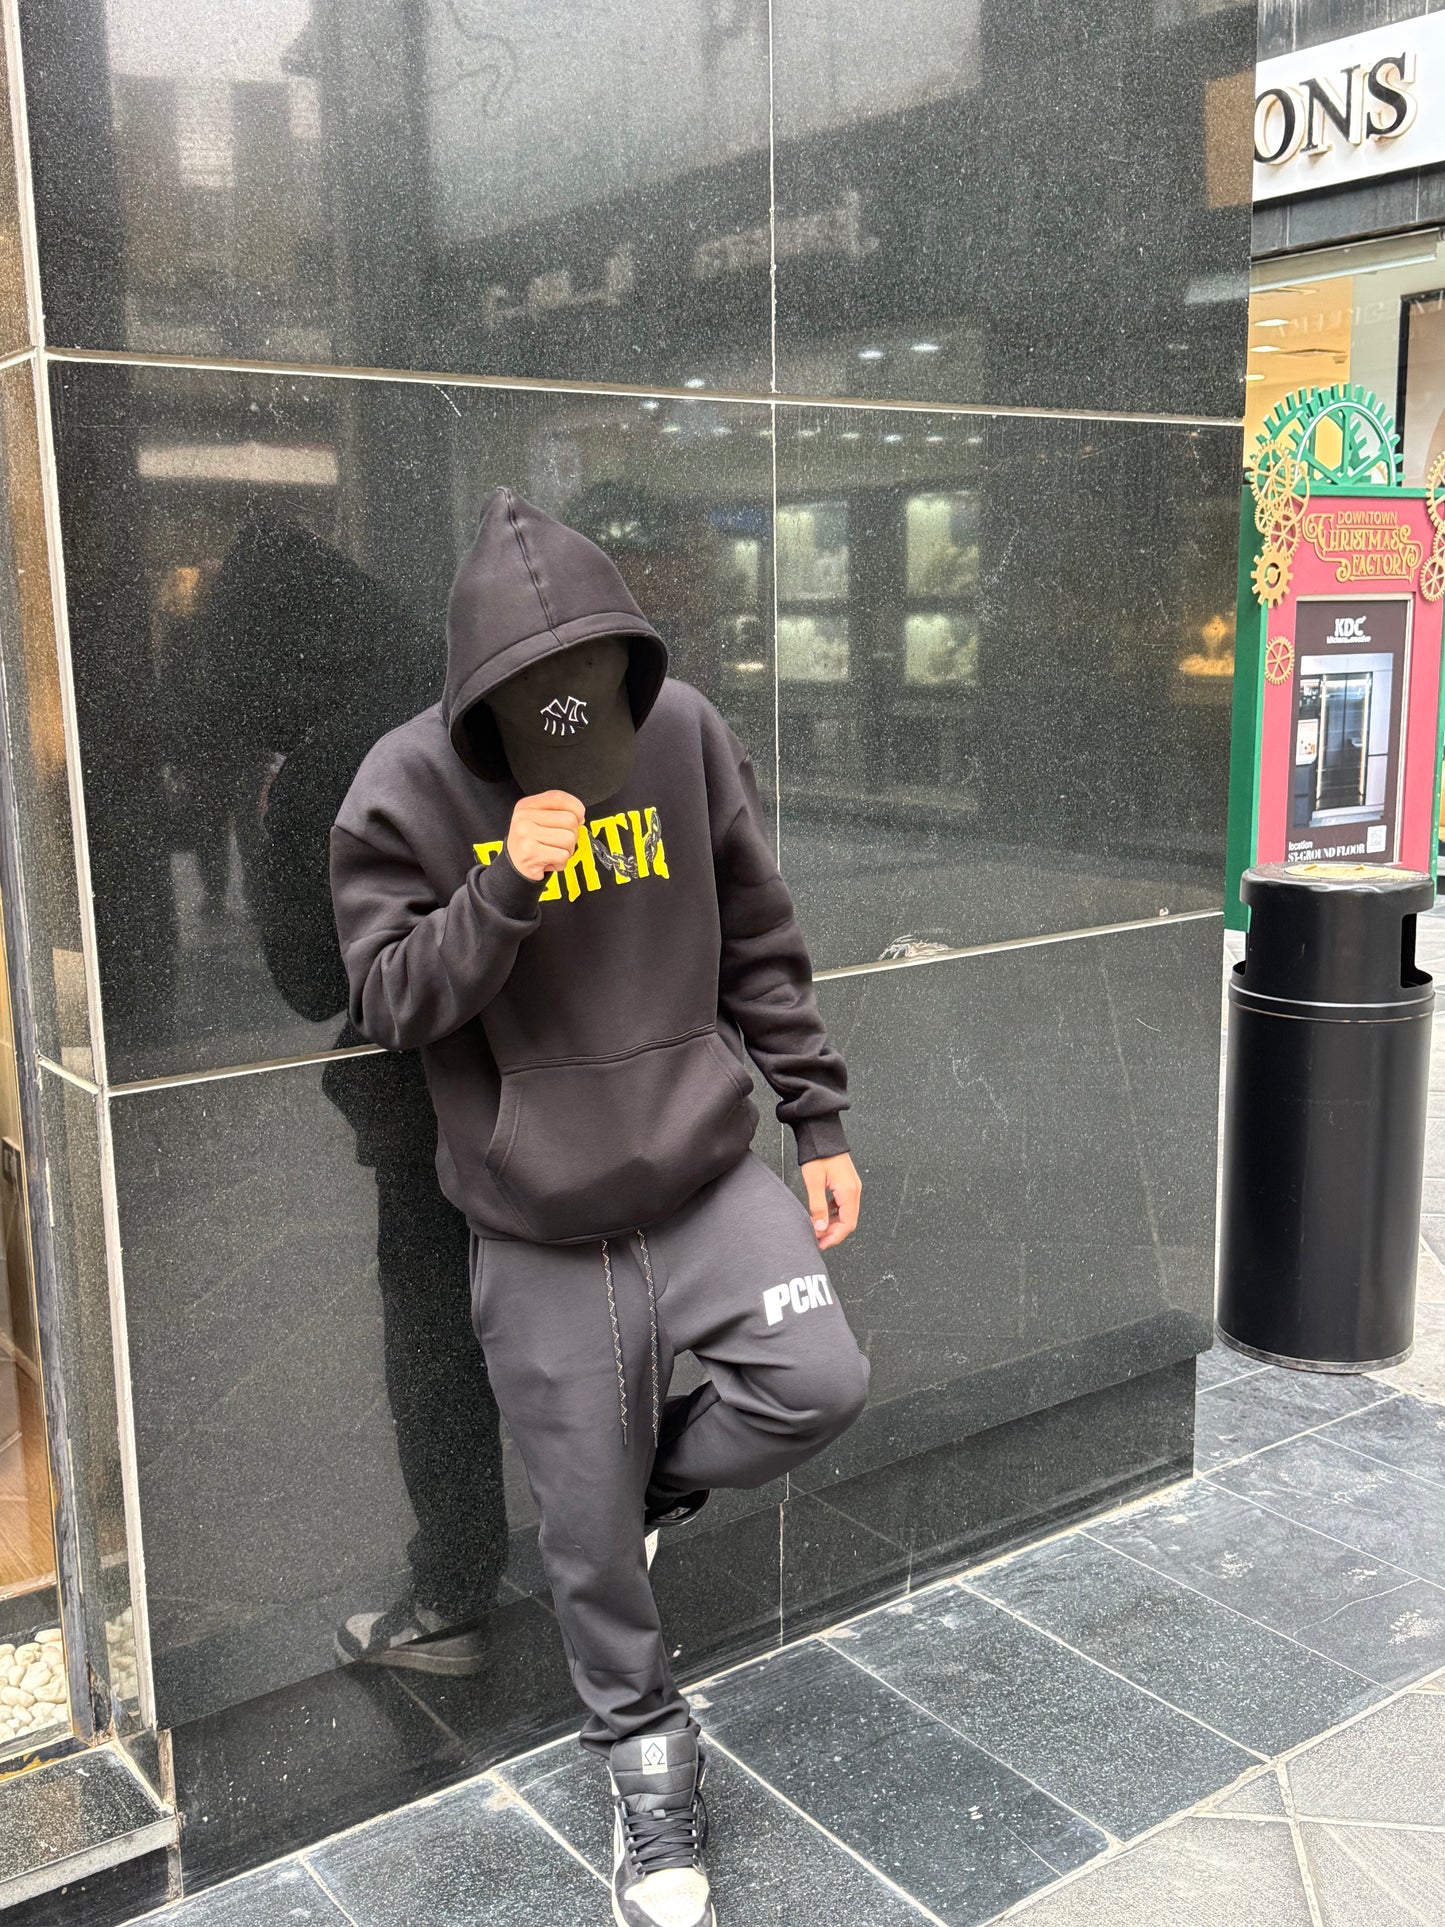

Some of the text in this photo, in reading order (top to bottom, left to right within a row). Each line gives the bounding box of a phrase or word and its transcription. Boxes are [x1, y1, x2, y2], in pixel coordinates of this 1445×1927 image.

[1254, 52, 1416, 165] ONS
[1337, 511, 1398, 525] DOWNTOWN
[1304, 513, 1402, 553] CHRISTMAS
[1350, 543, 1418, 577] FACTORY
[1335, 616, 1367, 637] KDC
[1288, 840, 1313, 851] location
[1336, 843, 1365, 857] FLOOR
[763, 1274, 833, 1326] PCKT
